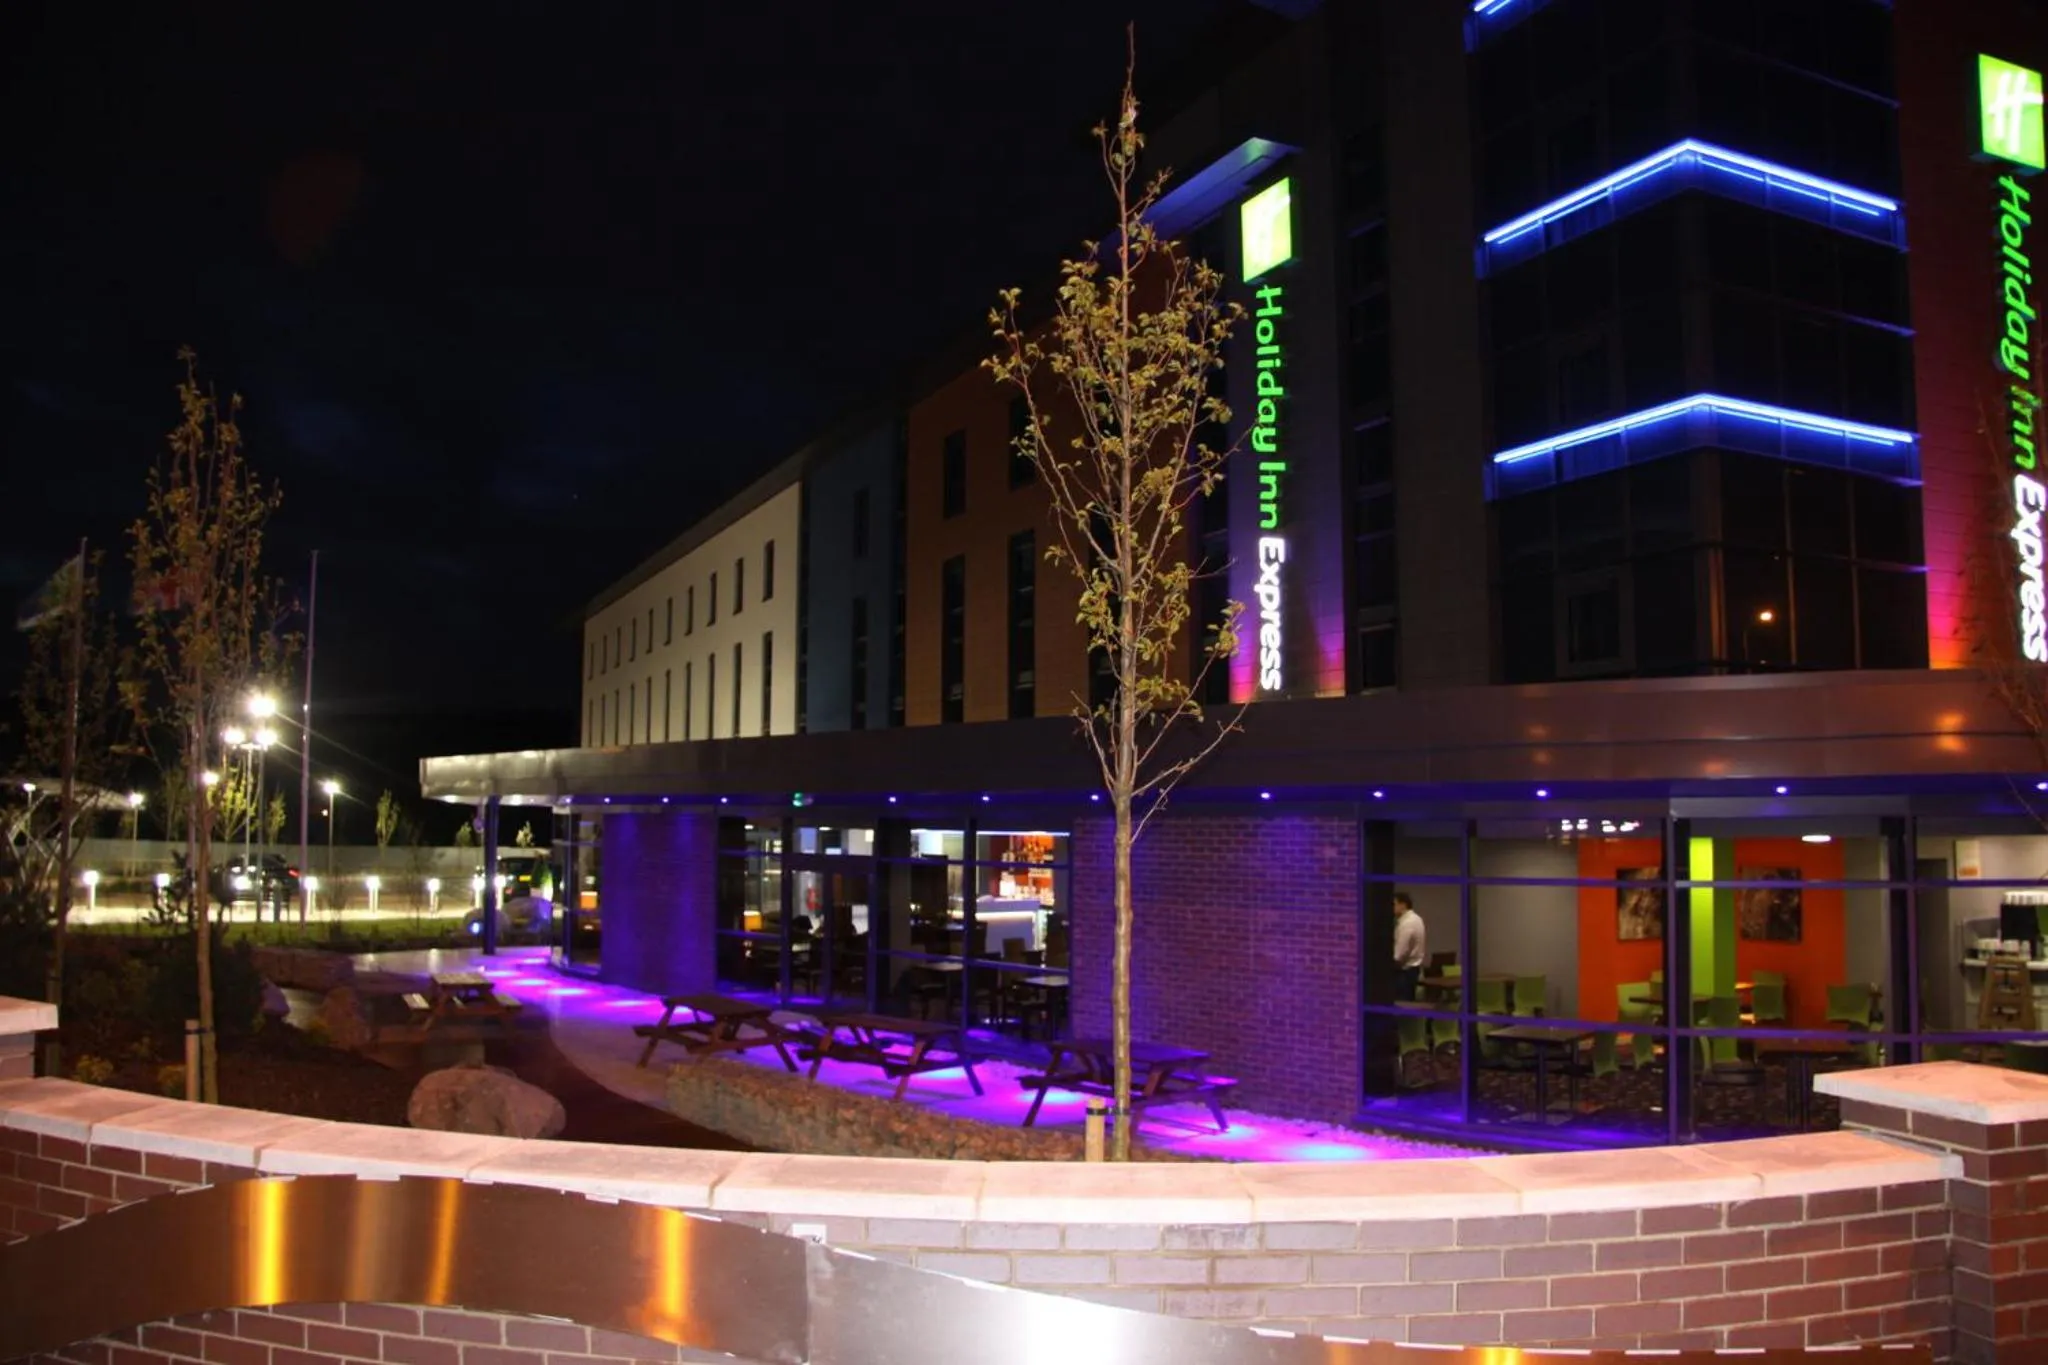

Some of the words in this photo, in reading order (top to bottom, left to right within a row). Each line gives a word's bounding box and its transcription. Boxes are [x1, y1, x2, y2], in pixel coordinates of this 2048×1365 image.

[1999, 176, 2036, 380] Holiday
[1252, 285, 1284, 452] Holiday
[2010, 385, 2042, 470] Inn
[1259, 462, 1286, 529] Inn
[2010, 473, 2048, 665] Express
[1254, 537, 1285, 691] Express
